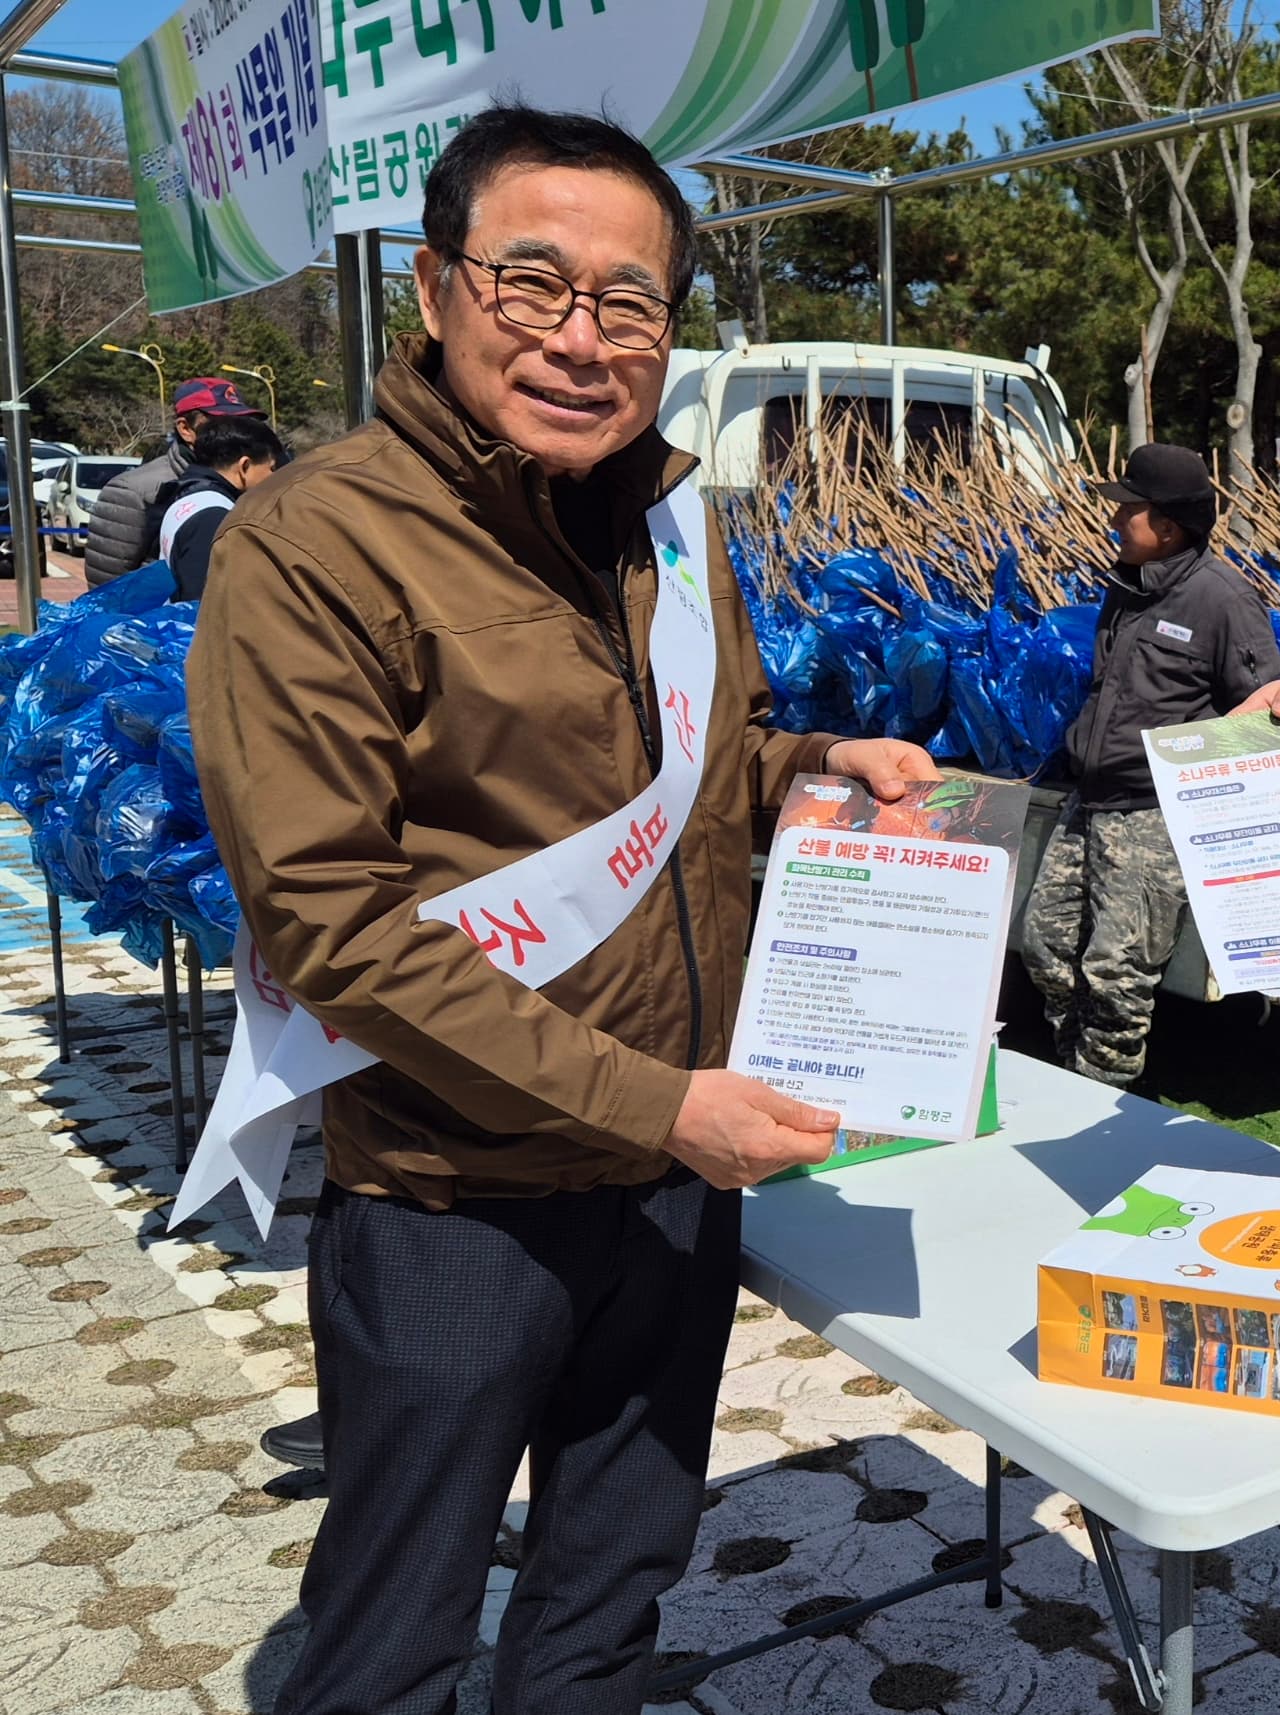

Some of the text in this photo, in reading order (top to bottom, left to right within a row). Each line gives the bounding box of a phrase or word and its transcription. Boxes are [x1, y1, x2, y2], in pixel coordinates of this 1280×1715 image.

[181, 82, 248, 200] 제81회
[236, 27, 295, 176] 식목일
[1177, 762, 1230, 783] 소나무류
[796, 837, 990, 874] 산불 예방 꼭! 지켜주세요!
[748, 1053, 865, 1081] 이제는 끝내야 합니다!
[766, 1076, 784, 1089] 피해
[786, 1078, 804, 1091] 신고
[919, 1108, 952, 1123] 함평군
